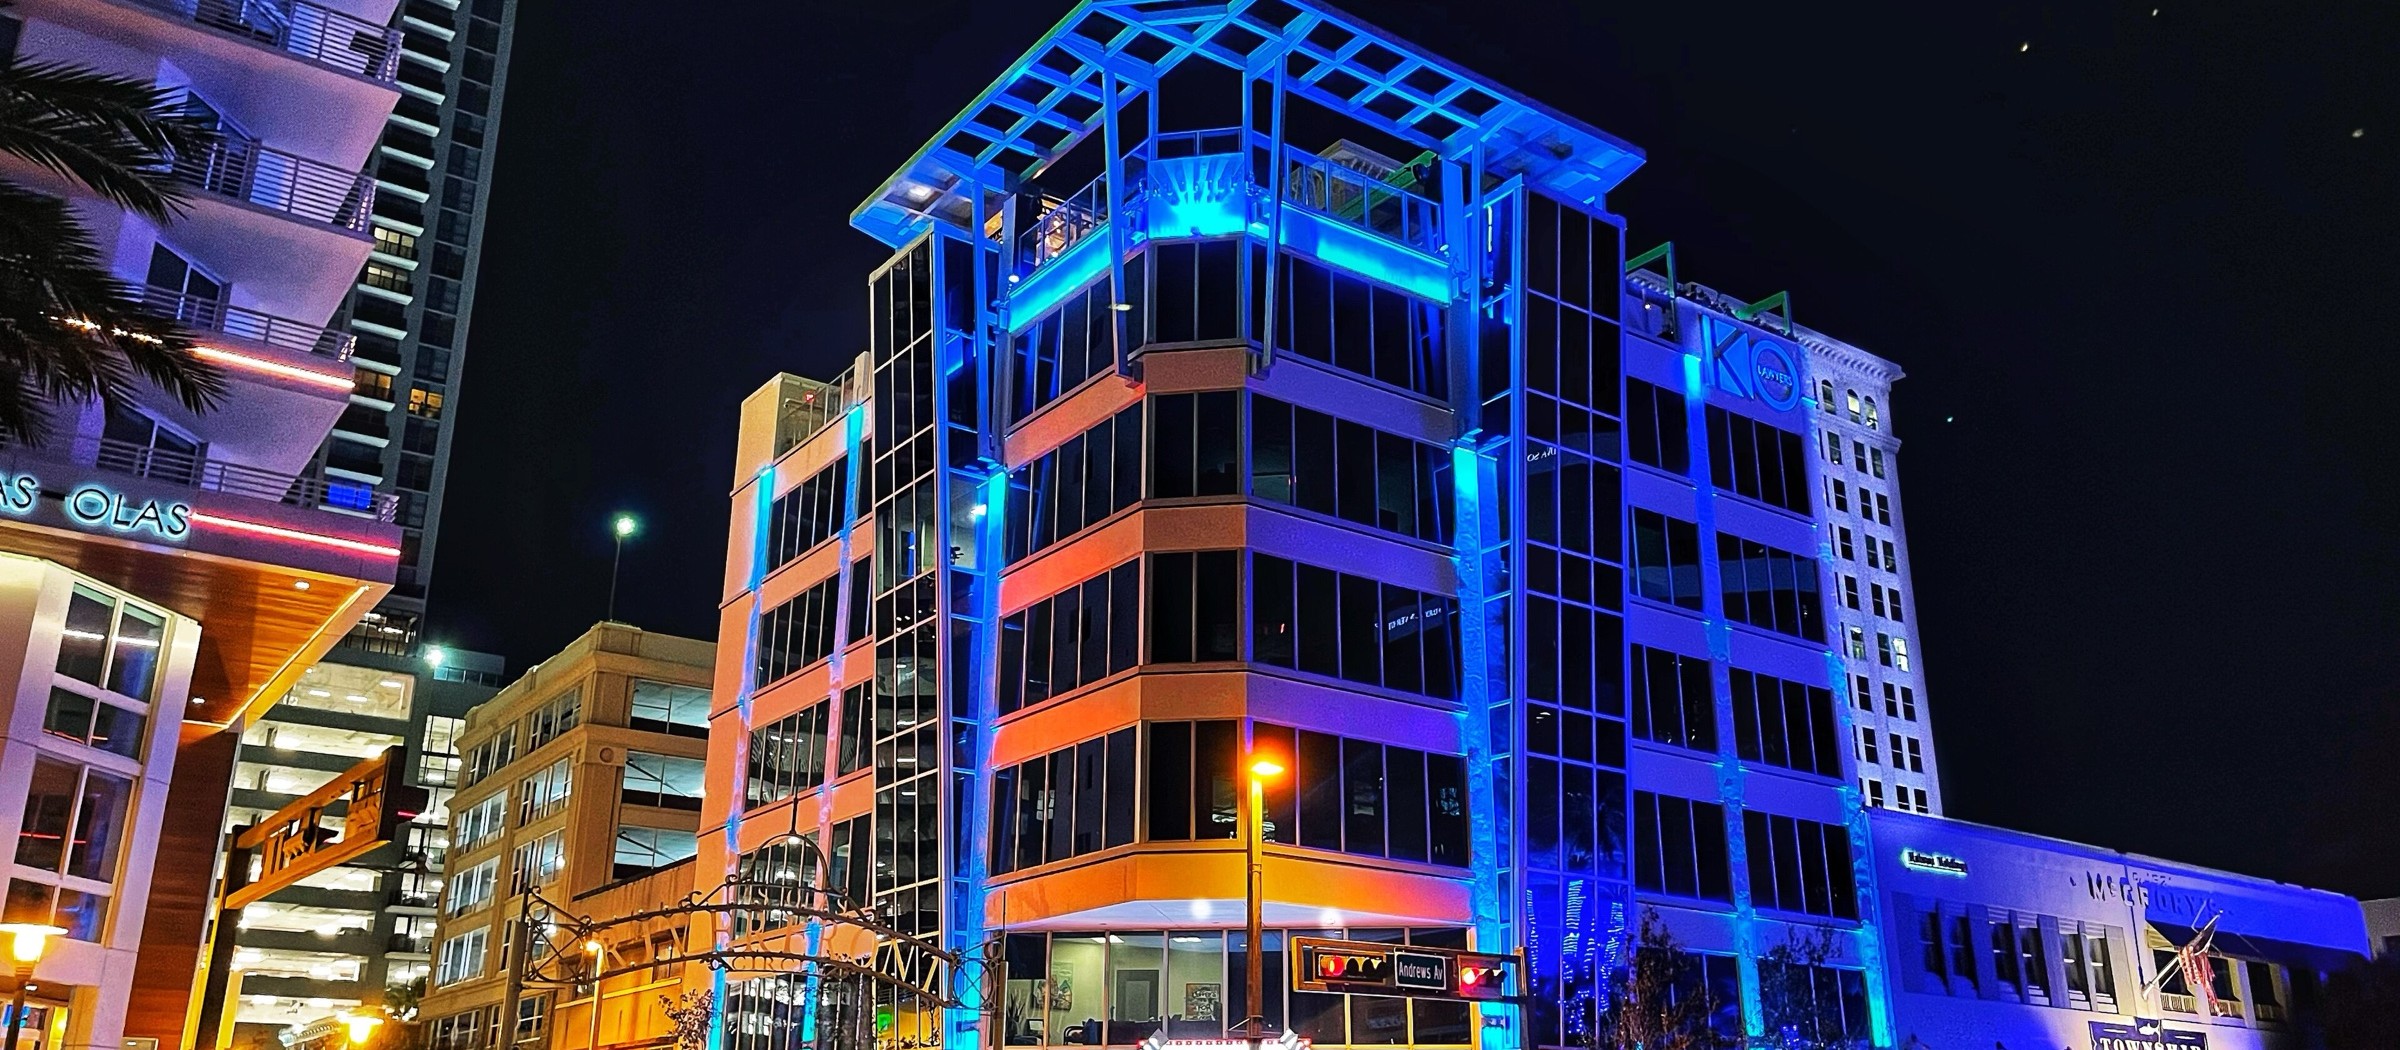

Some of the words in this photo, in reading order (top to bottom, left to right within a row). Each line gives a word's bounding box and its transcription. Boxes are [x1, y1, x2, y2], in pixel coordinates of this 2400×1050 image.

[1700, 312, 1800, 412] KO
[1757, 364, 1793, 387] LAWYERS
[0, 476, 36, 509] S
[73, 487, 189, 535] OLAS
[1398, 961, 1431, 980] Andrews
[1433, 964, 1443, 981] Av
